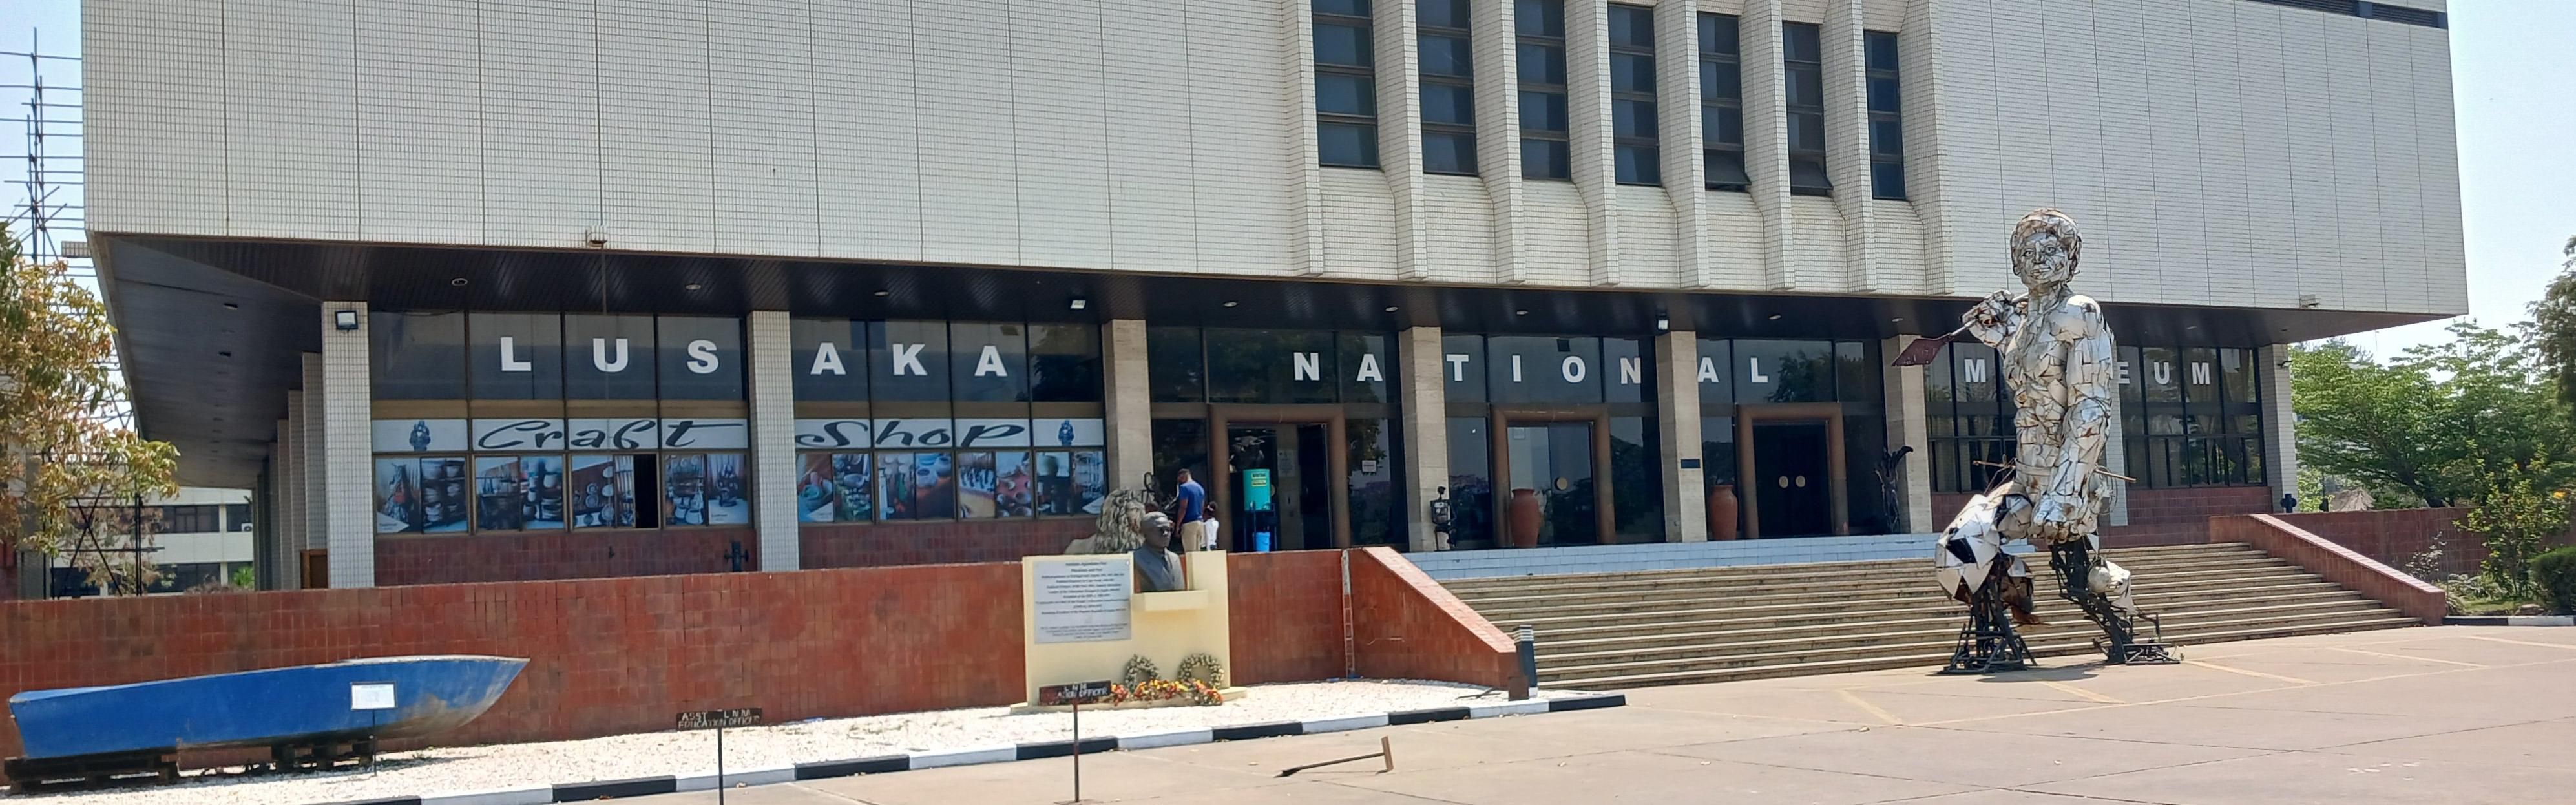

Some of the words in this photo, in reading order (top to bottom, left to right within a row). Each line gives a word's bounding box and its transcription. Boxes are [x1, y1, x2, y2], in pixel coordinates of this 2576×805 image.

[501, 336, 1008, 376] LUSAKA
[1293, 351, 1768, 384] NATIONAL
[1964, 359, 2211, 385] MEUM
[478, 419, 743, 450] Craft
[795, 419, 1026, 448] Shop
[682, 711, 707, 721] ASST
